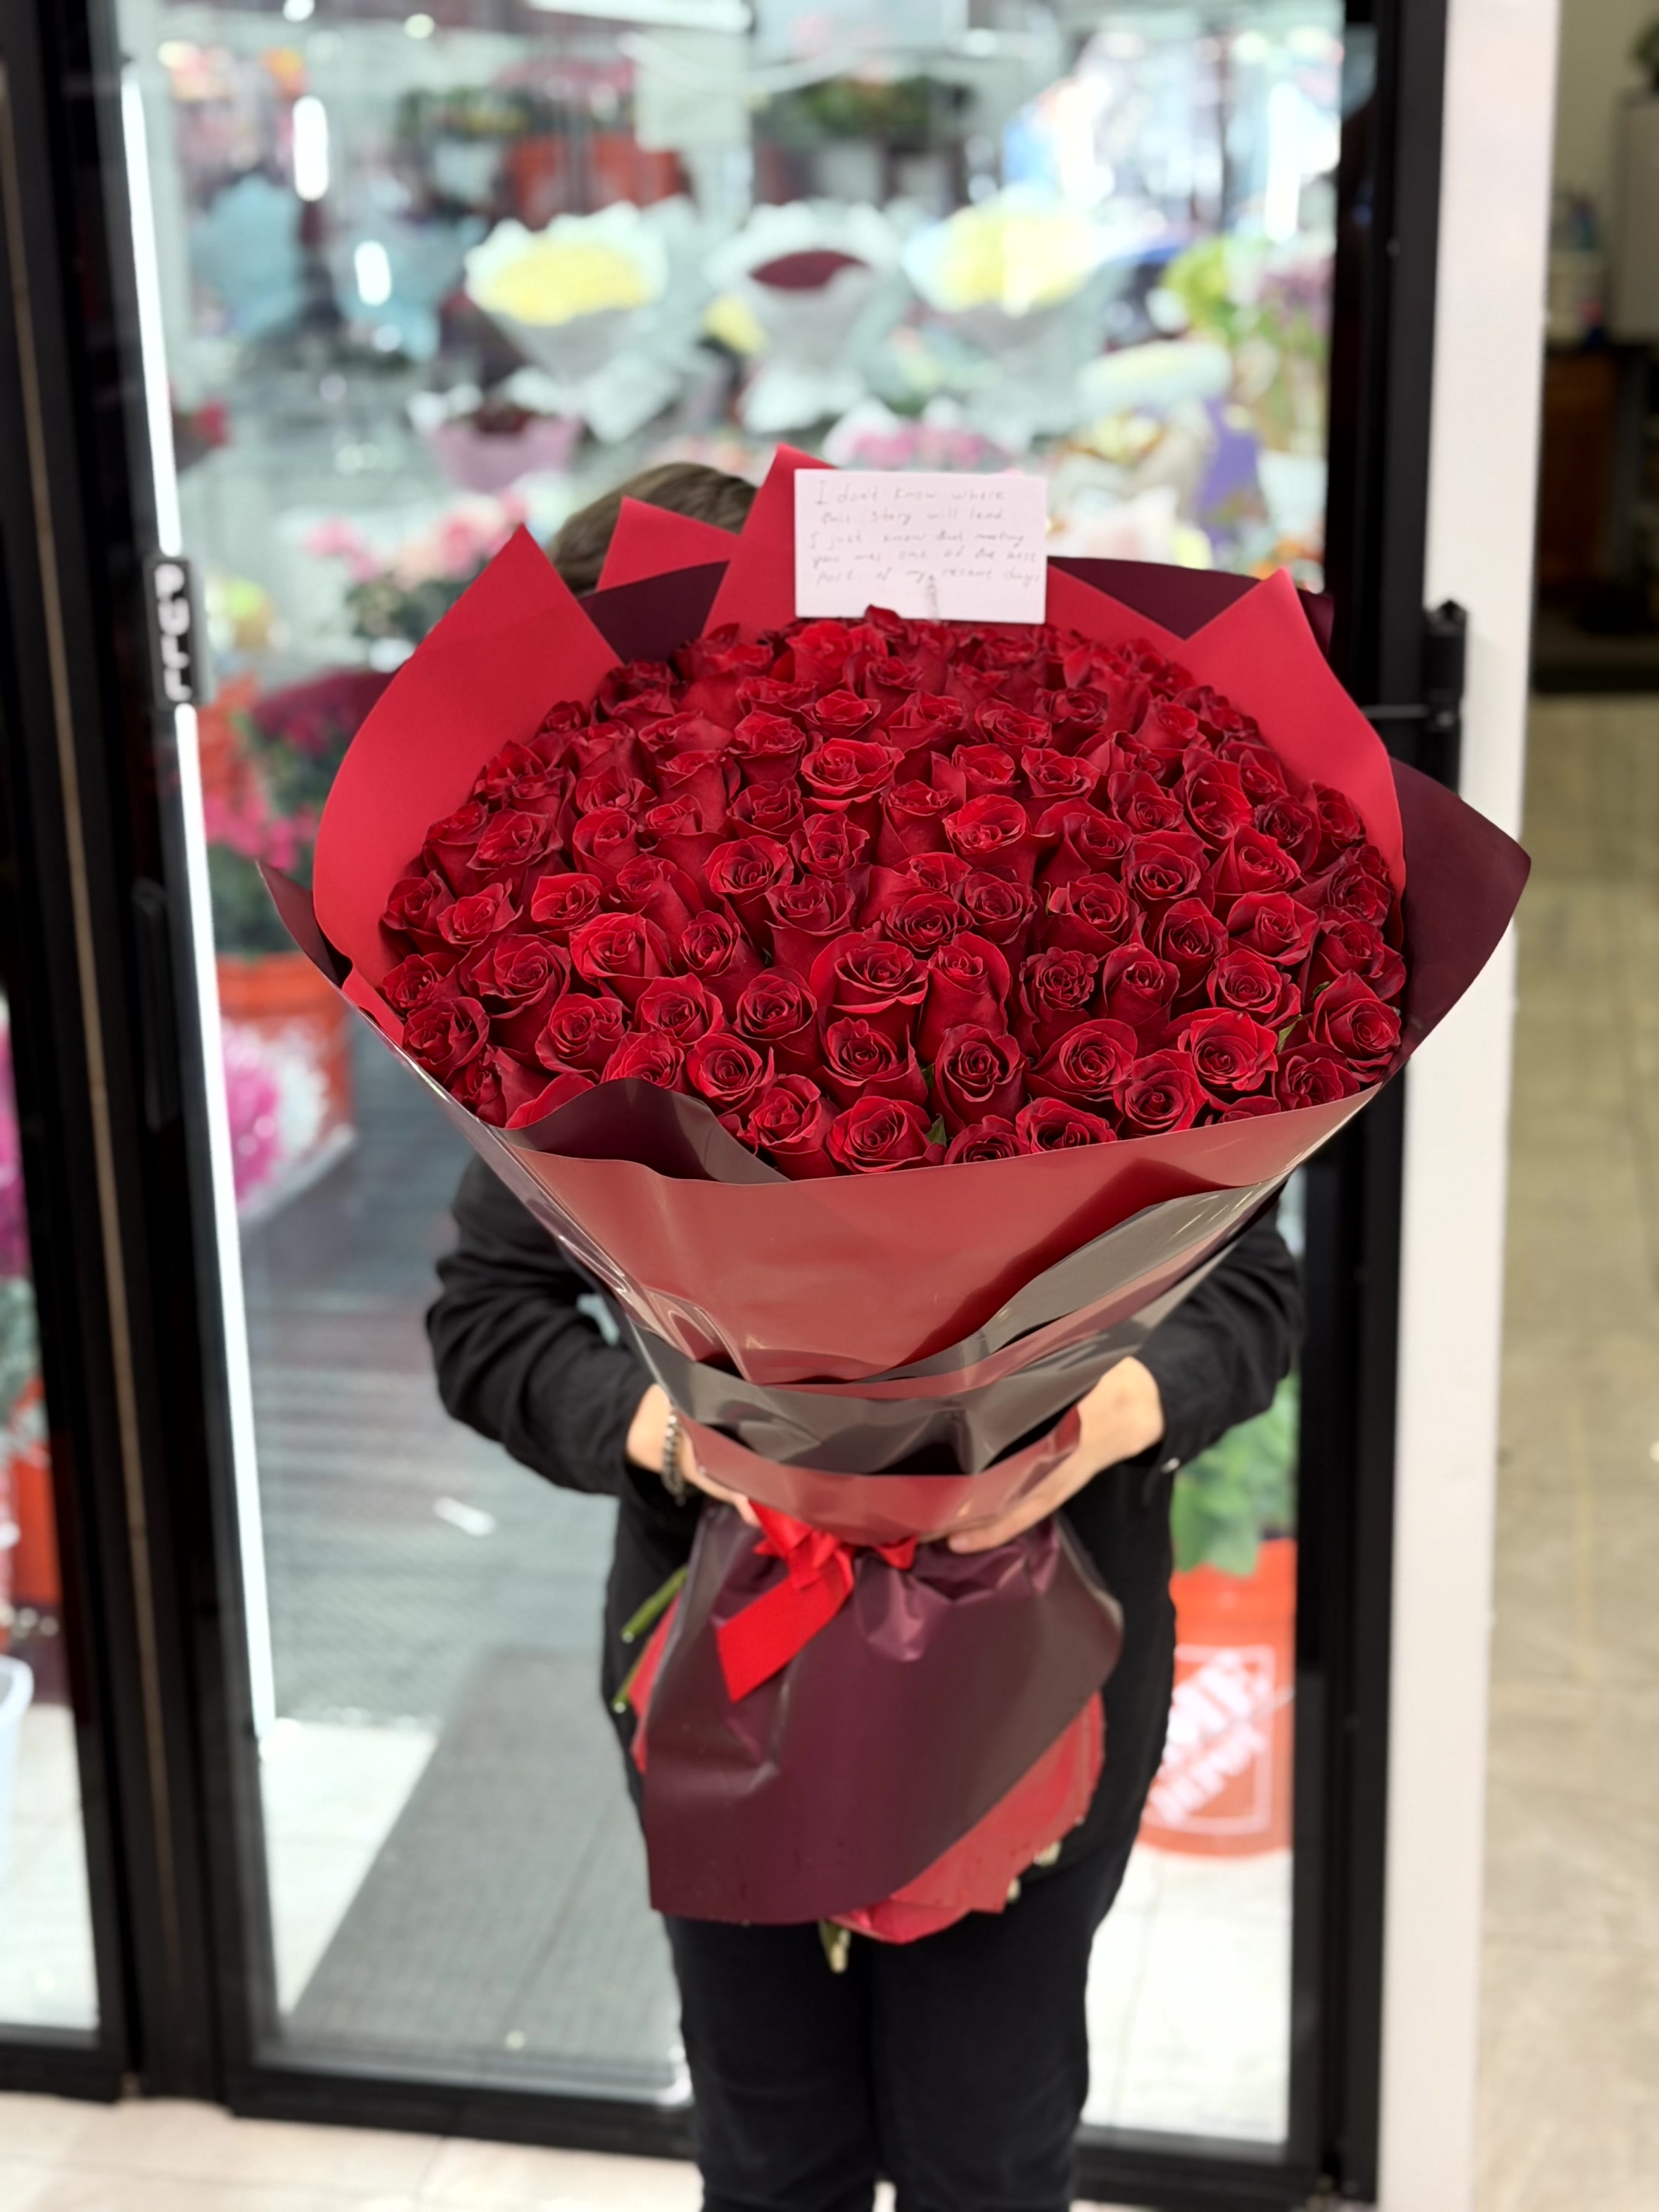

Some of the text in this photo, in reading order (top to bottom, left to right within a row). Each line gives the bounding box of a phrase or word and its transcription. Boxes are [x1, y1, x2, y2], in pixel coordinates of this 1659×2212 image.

[814, 479, 828, 506] I
[951, 486, 1005, 501] where
[927, 506, 958, 520] will
[809, 530, 820, 550] I
[827, 529, 863, 551] just
[154, 562, 193, 702] PULL
